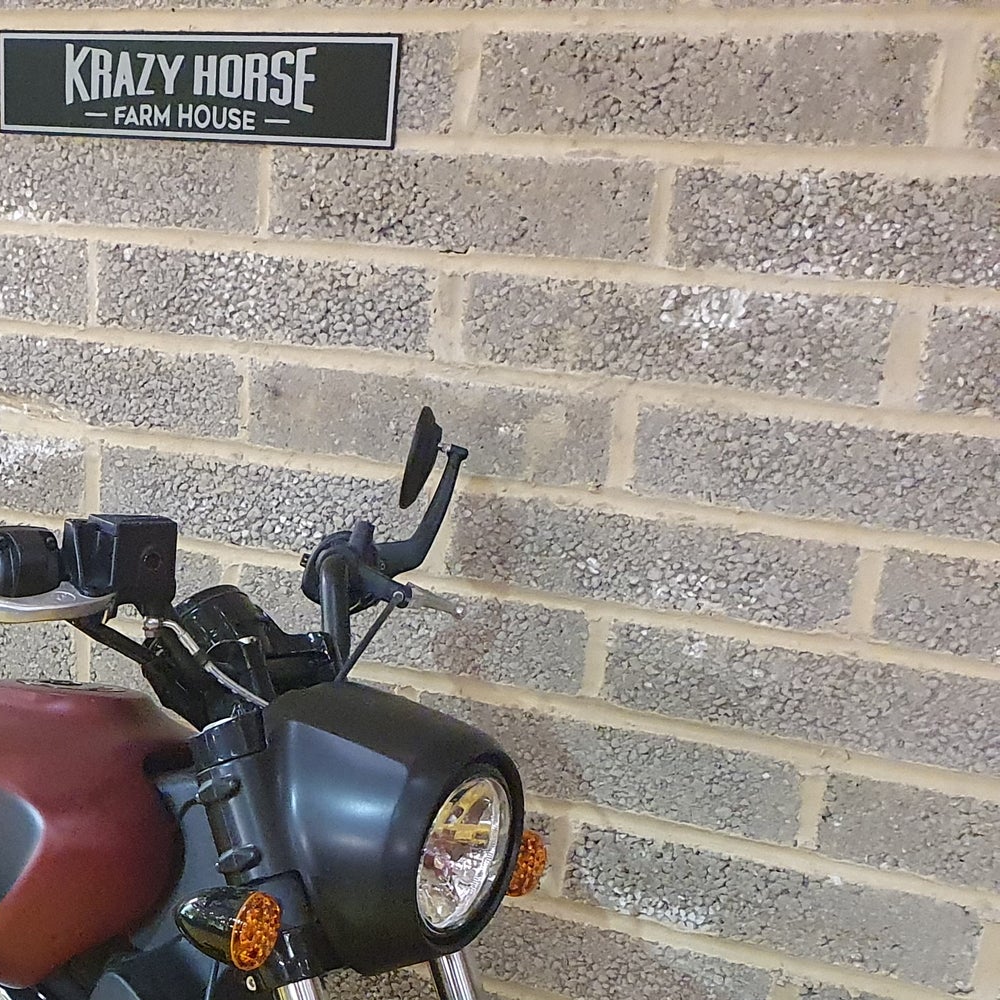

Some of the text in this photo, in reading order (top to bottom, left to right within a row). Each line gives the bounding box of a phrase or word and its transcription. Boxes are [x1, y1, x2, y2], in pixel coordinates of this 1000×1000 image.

[64, 43, 317, 113] KRAZY HORSE
[114, 103, 256, 131] FARM HOUSE
